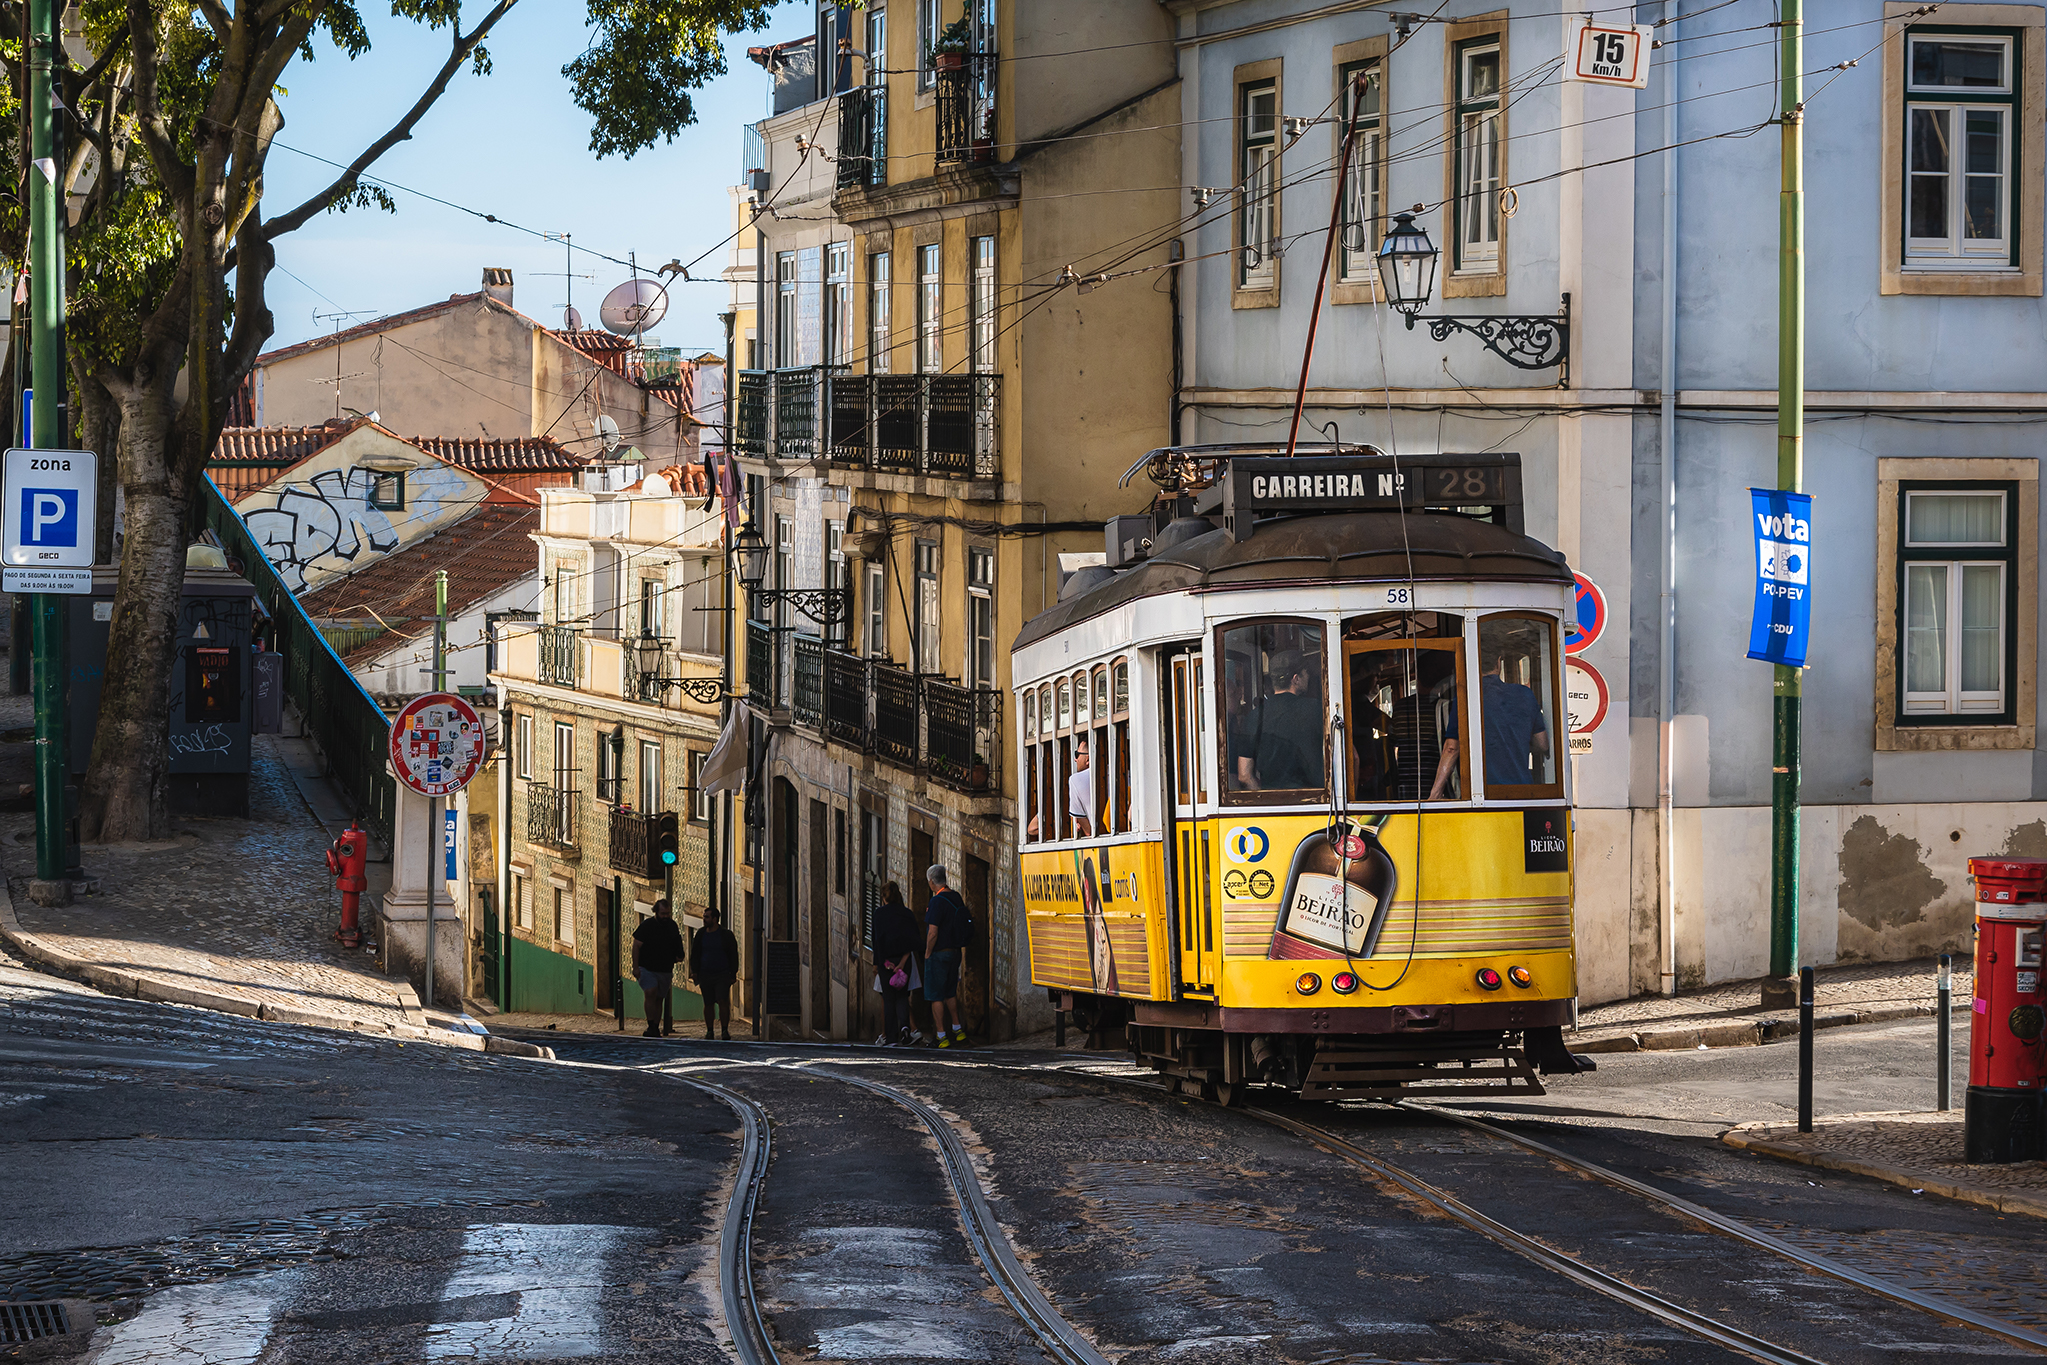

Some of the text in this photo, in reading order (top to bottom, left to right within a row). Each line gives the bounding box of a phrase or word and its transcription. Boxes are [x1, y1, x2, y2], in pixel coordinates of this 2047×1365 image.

[1593, 33, 1625, 64] 15
[1592, 63, 1621, 77] Km/h
[30, 459, 71, 471] zona
[1252, 474, 1365, 499] CARREIRA
[1438, 467, 1486, 497] 28
[32, 493, 66, 541] P
[1757, 512, 1809, 542] vota
[1568, 738, 1592, 749] ARROS
[1530, 837, 1565, 853] BEIRÃO
[1296, 893, 1364, 929] BEIRÃO
